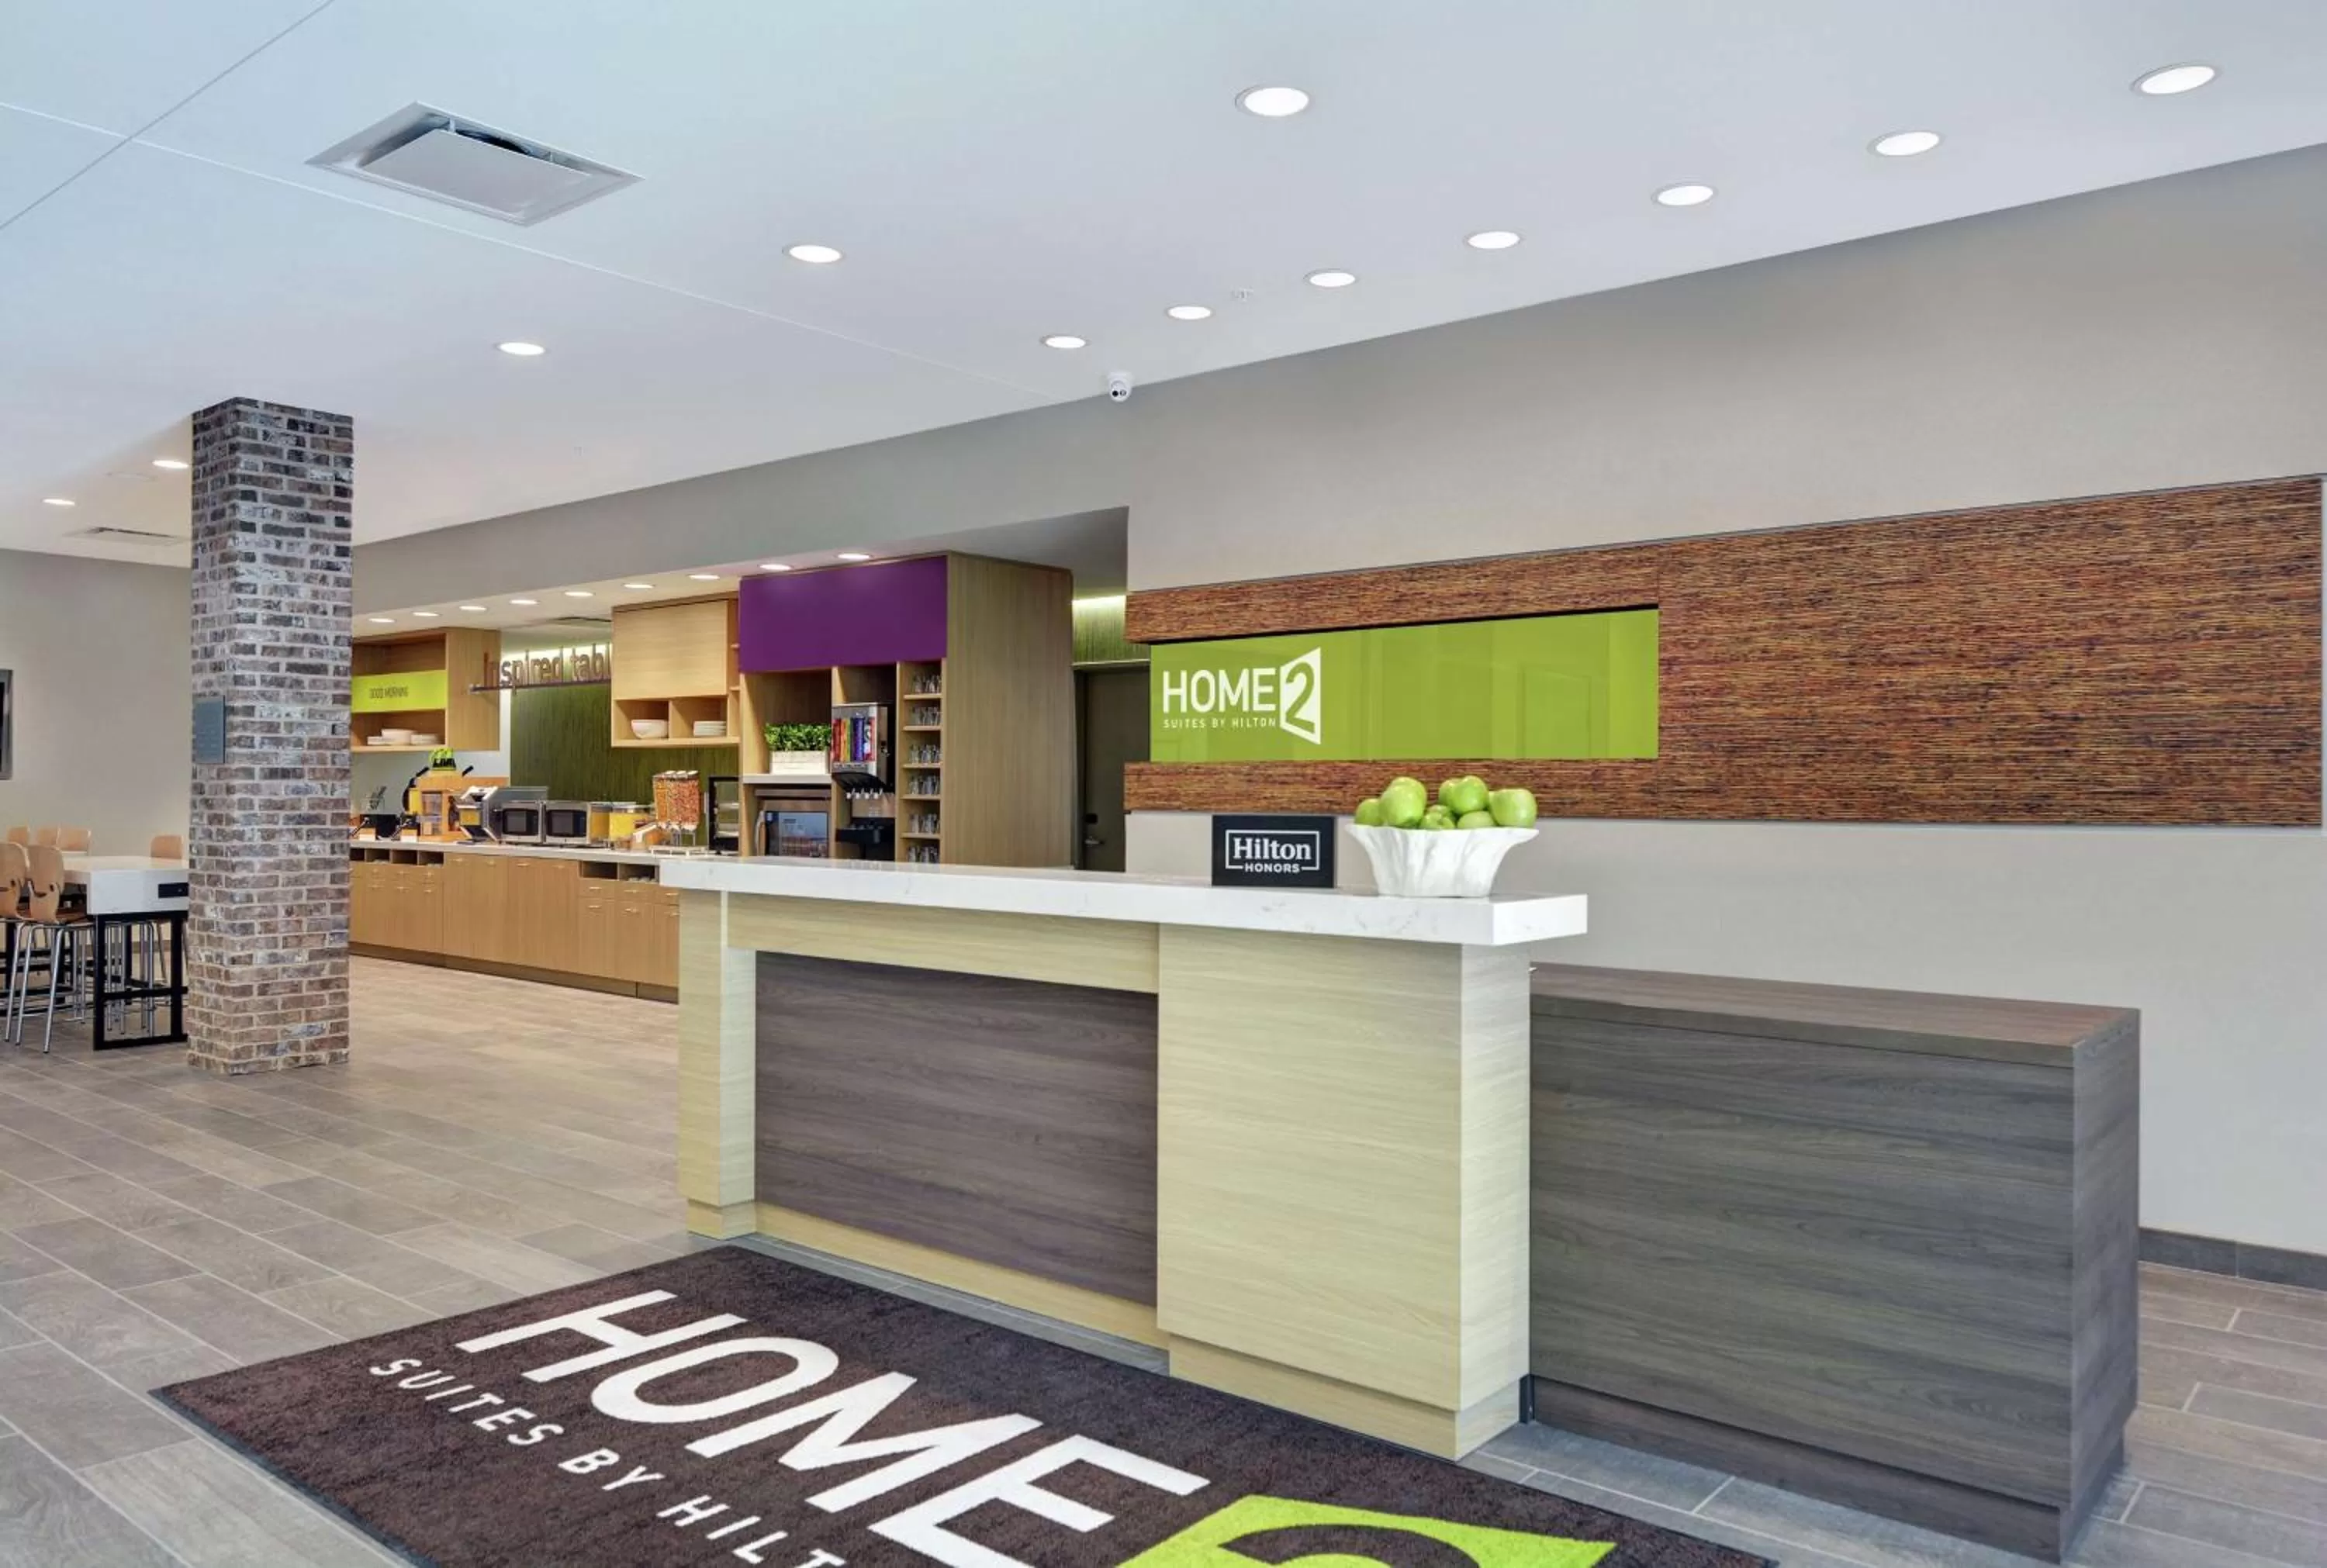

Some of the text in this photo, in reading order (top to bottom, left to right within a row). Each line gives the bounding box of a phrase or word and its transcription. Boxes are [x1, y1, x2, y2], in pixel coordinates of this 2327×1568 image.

[1164, 717, 1276, 728] SUITES BY HILTON
[1233, 837, 1312, 860] Hilton
[1245, 862, 1300, 873] HONORS
[369, 1358, 565, 1446] SUITES
[558, 1448, 666, 1491] BY
